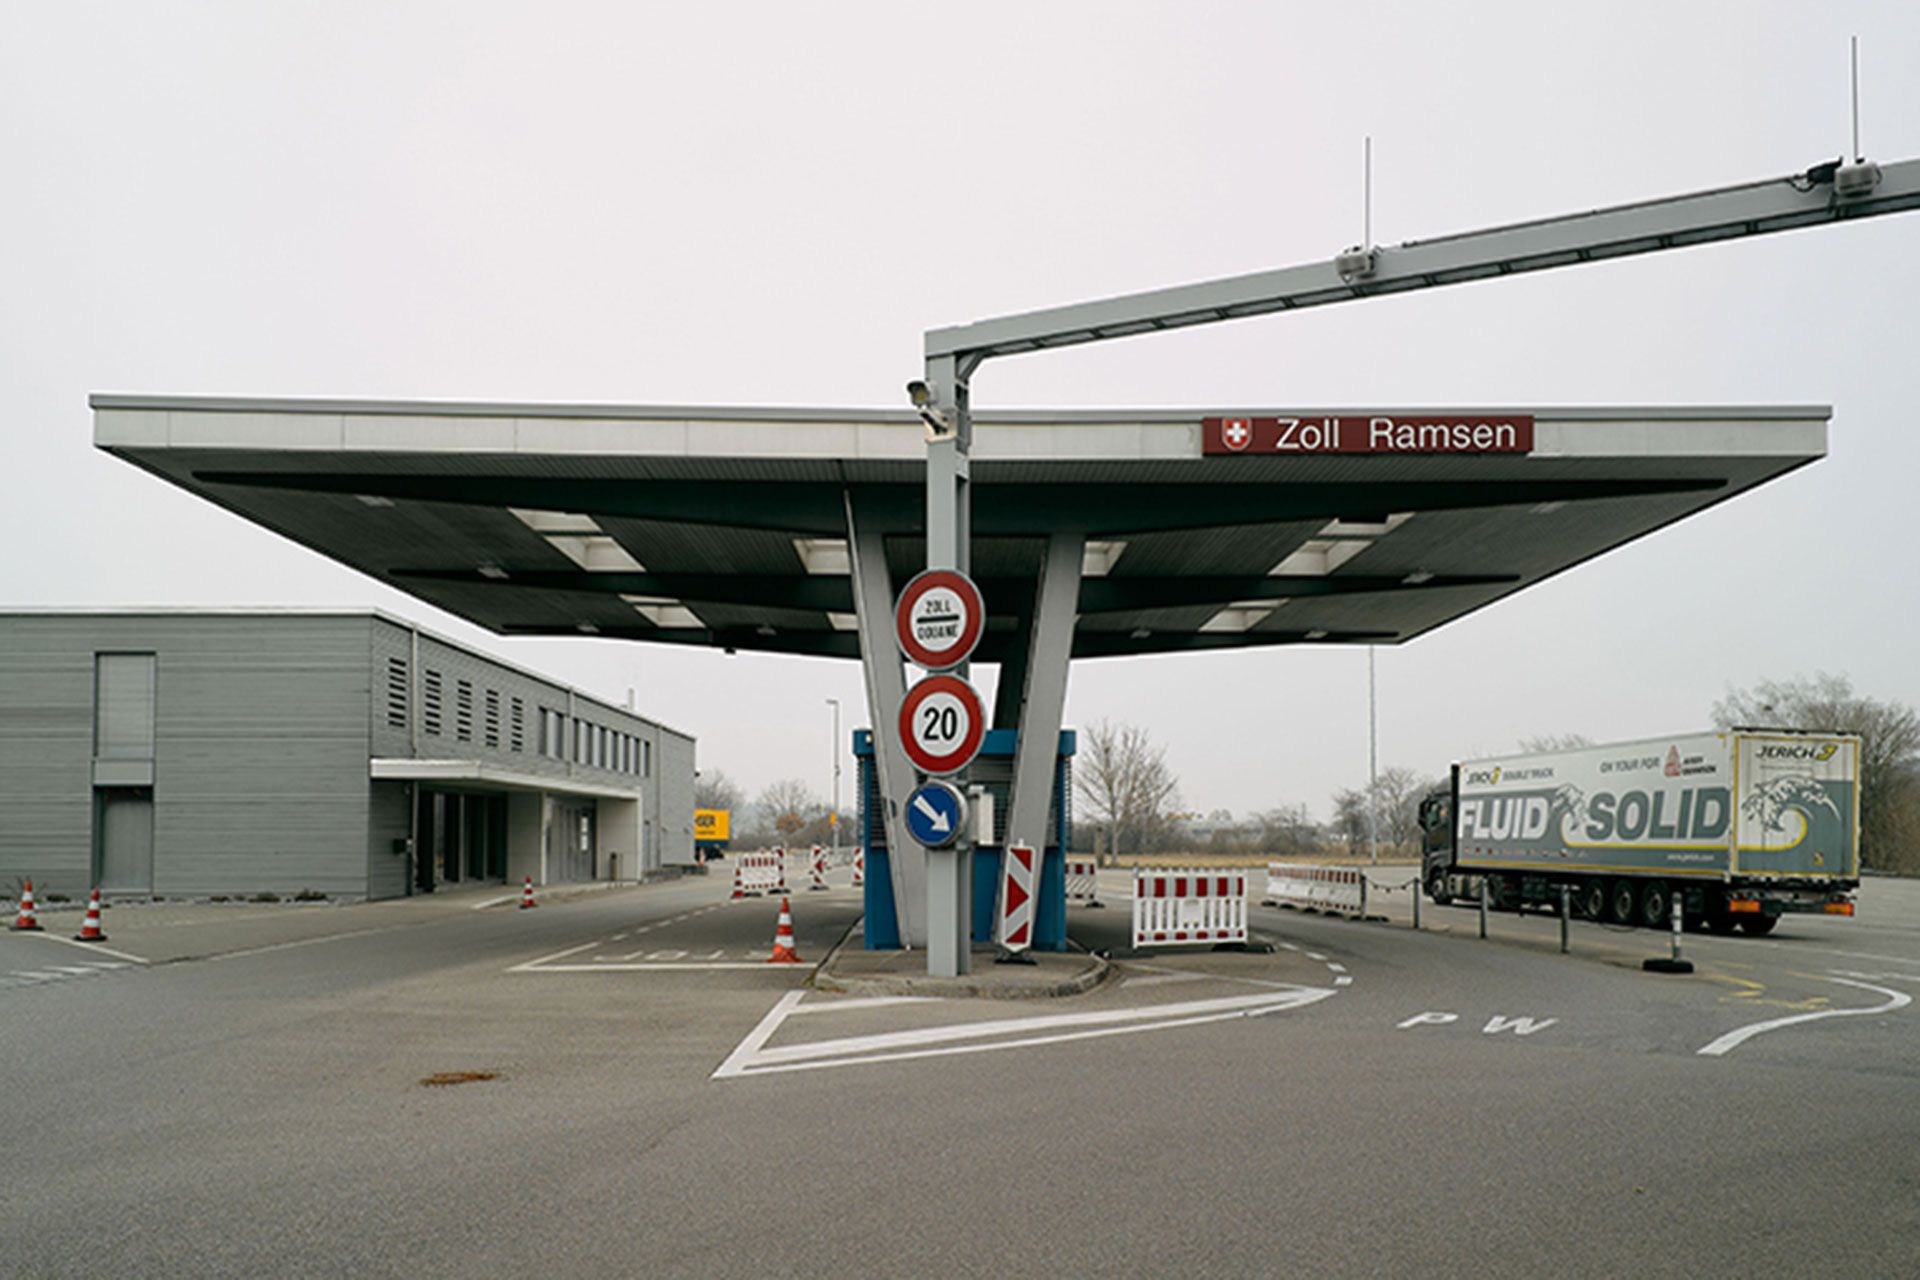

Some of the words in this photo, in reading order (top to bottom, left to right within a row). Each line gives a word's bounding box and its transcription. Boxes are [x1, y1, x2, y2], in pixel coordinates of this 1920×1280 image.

[1275, 418, 1340, 450] Zoll
[1369, 418, 1516, 449] Ramsen
[925, 600, 951, 614] ZOLL
[917, 624, 958, 640] DOUANE
[923, 706, 958, 742] 20
[1458, 797, 1550, 842] FLUID
[1584, 786, 1731, 841] SOLID
